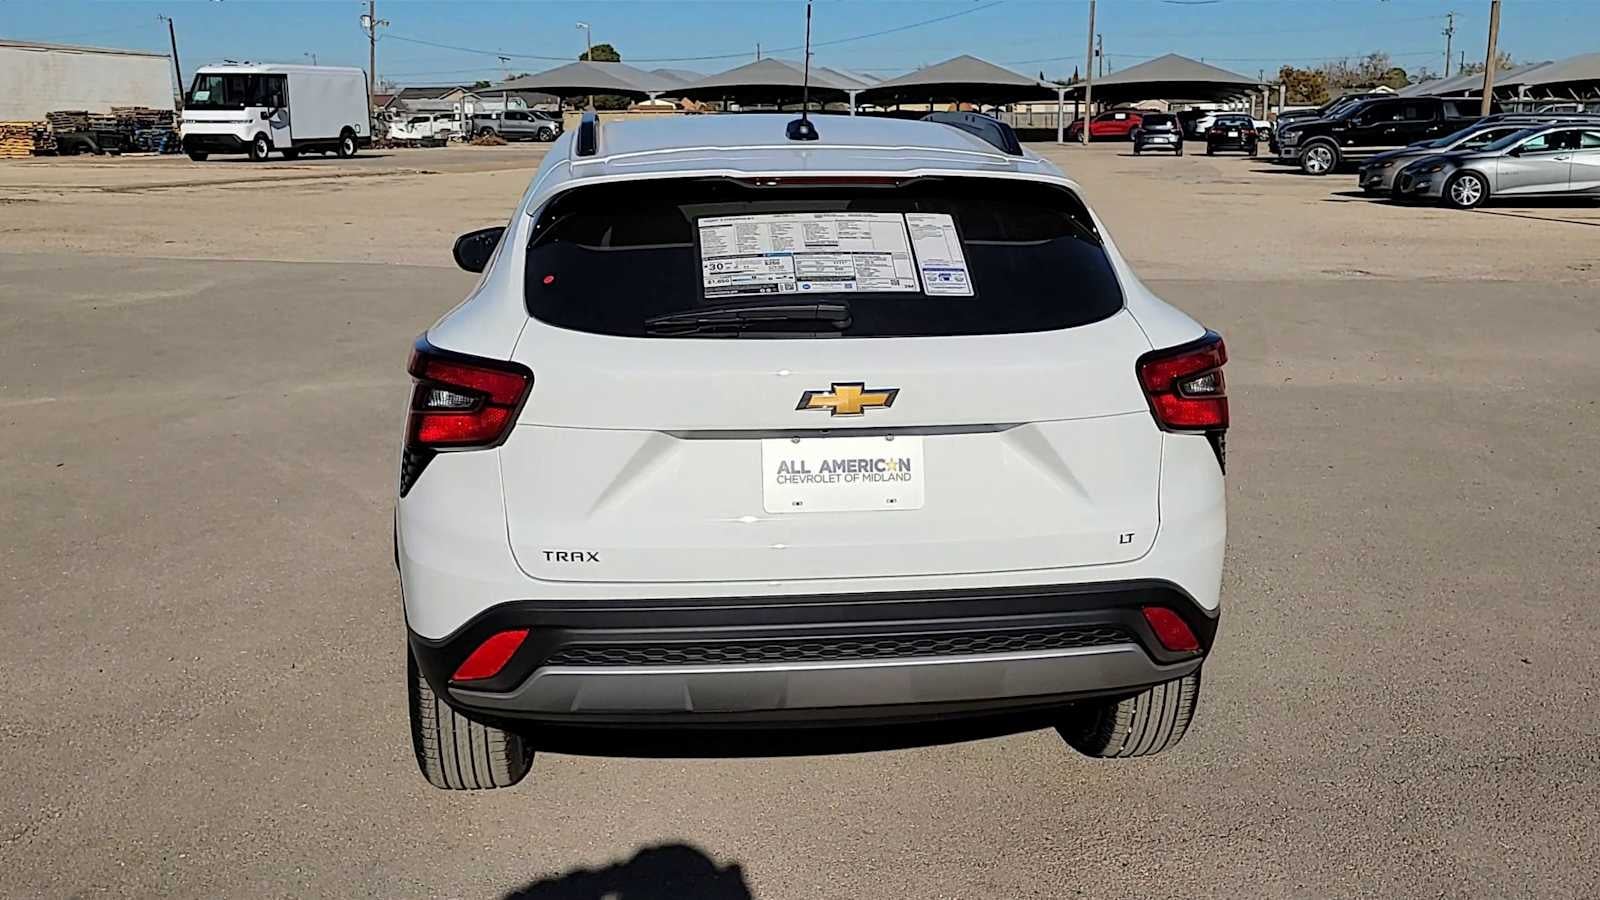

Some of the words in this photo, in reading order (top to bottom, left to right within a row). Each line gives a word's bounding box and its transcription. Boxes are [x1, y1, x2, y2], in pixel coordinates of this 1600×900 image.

[708, 262, 724, 271] 30
[776, 460, 812, 474] ALL
[776, 473, 842, 485] CHEVROLET
[844, 473, 860, 483] OF
[862, 472, 912, 482] MIDLAND
[1119, 532, 1135, 544] LT
[542, 550, 600, 562] TRAX
